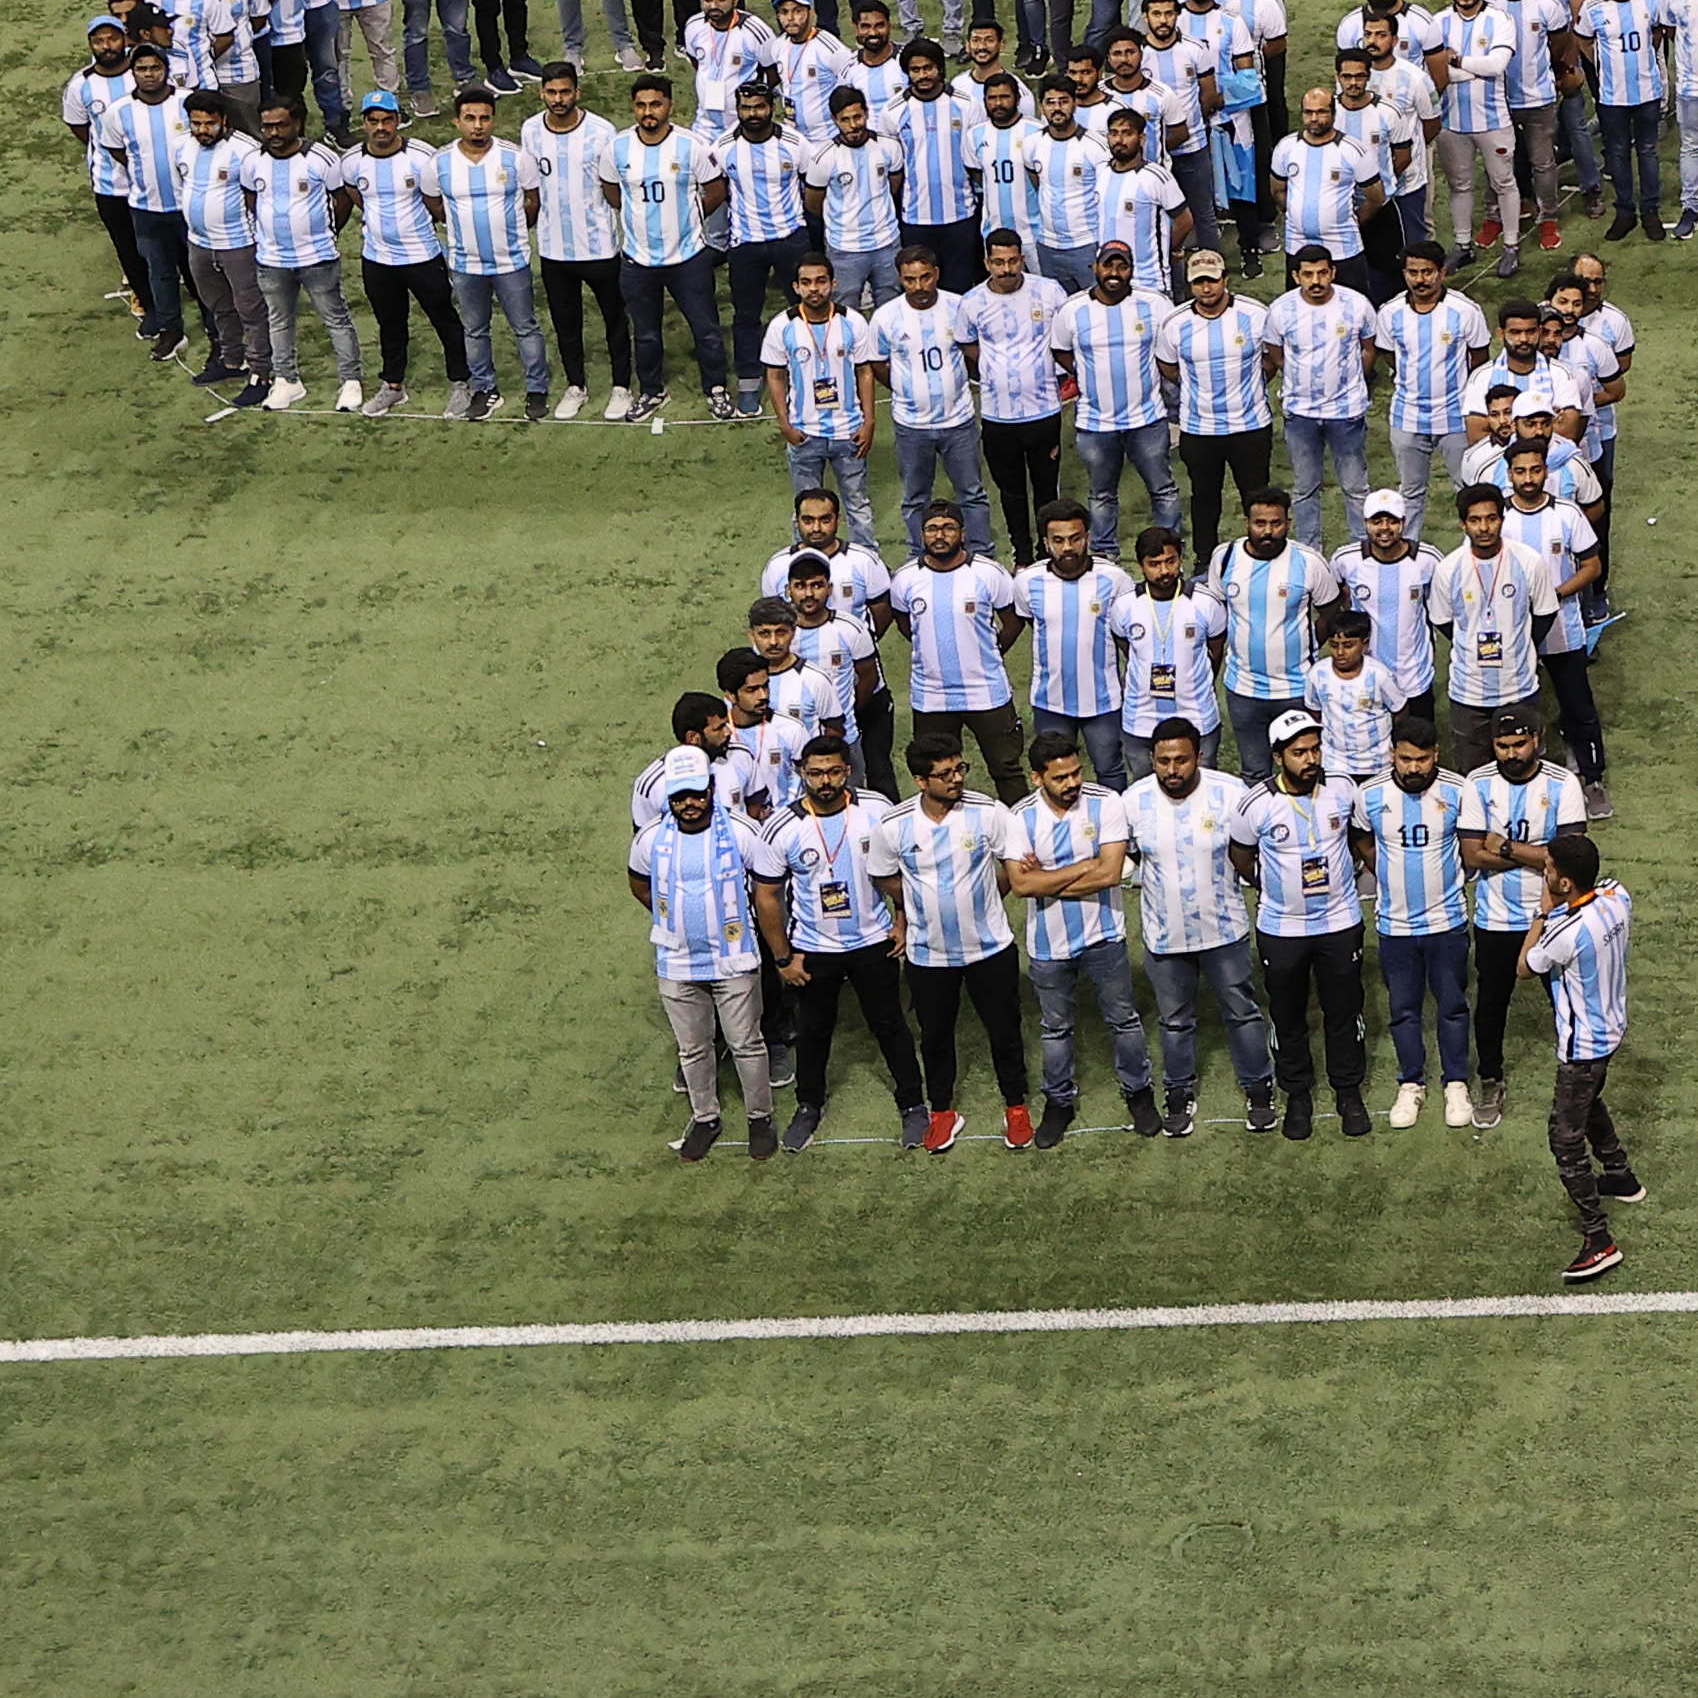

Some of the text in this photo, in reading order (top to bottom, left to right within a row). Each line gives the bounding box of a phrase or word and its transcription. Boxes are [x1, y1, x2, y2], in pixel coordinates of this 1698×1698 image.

[1620, 31, 1641, 52] 10
[992, 157, 1016, 183] 10
[639, 180, 665, 203] 10
[918, 348, 944, 373] 10
[1397, 824, 1430, 849] 10
[1504, 818, 1530, 843] 10
